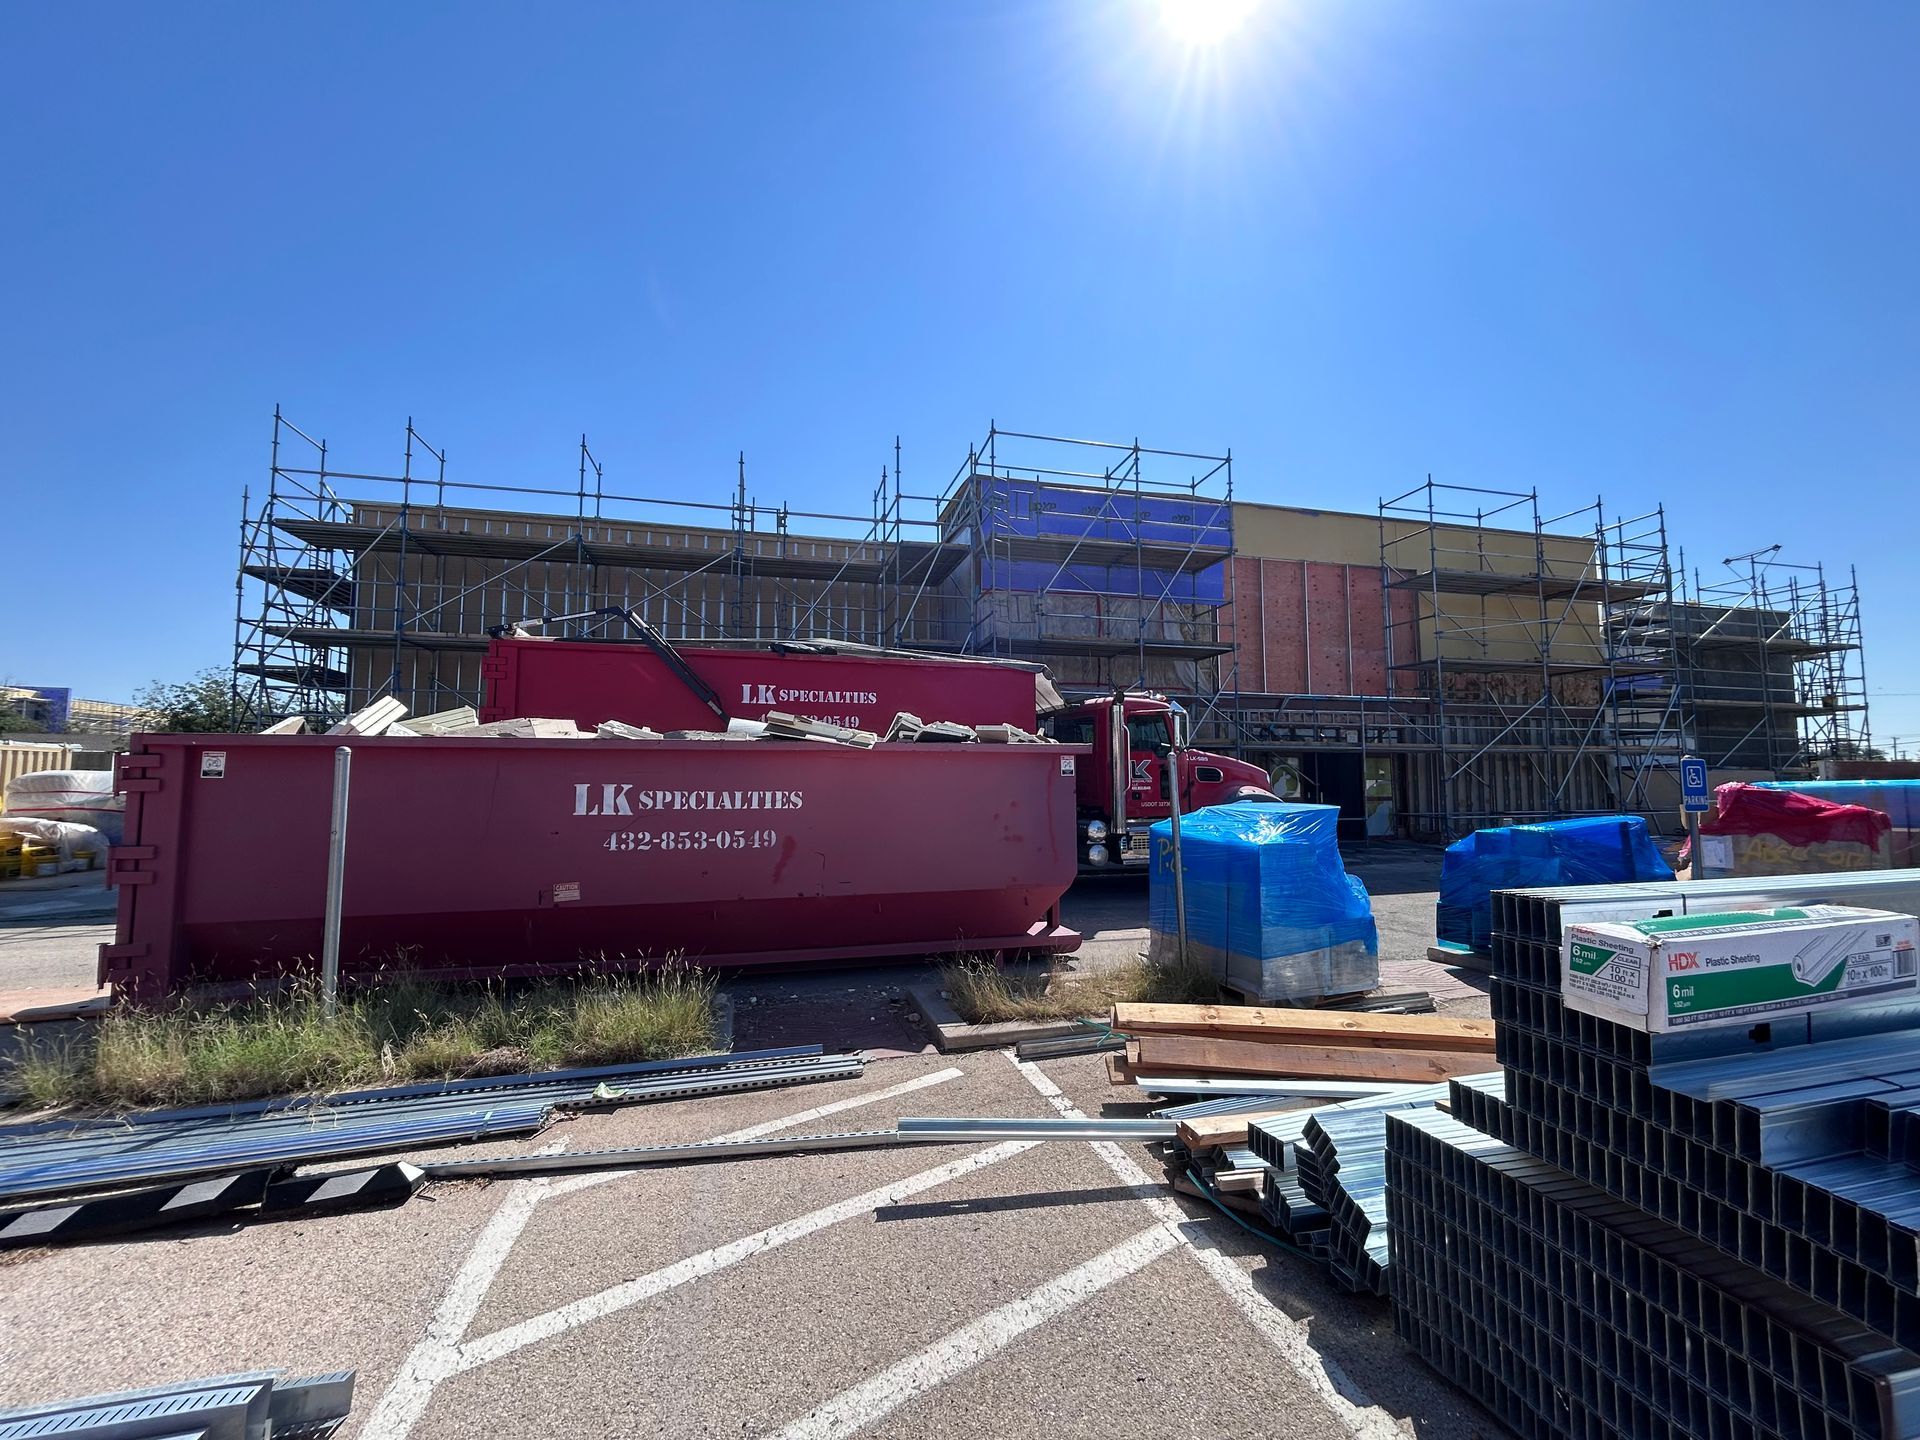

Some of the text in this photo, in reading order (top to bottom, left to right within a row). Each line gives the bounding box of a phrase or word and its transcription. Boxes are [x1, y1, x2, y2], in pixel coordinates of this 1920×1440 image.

[741, 684, 877, 705] LK SPECIALTIES
[572, 783, 804, 816] LK SPECIALTIES
[1684, 795, 1708, 805] PARKING
[603, 829, 777, 851] 432-853-0549
[1571, 933, 1634, 954] Plastic Sheeting
[1572, 945, 1597, 960] 6 mil
[1850, 954, 1870, 963] CLEAR
[1617, 956, 1638, 965] CLEAR
[1667, 952, 1700, 971] HDX
[1705, 954, 1761, 967] Plastic Sheeting
[1610, 965, 1621, 974] 10
[1610, 973, 1626, 983] 100
[1672, 984, 1694, 998] 6 mil
